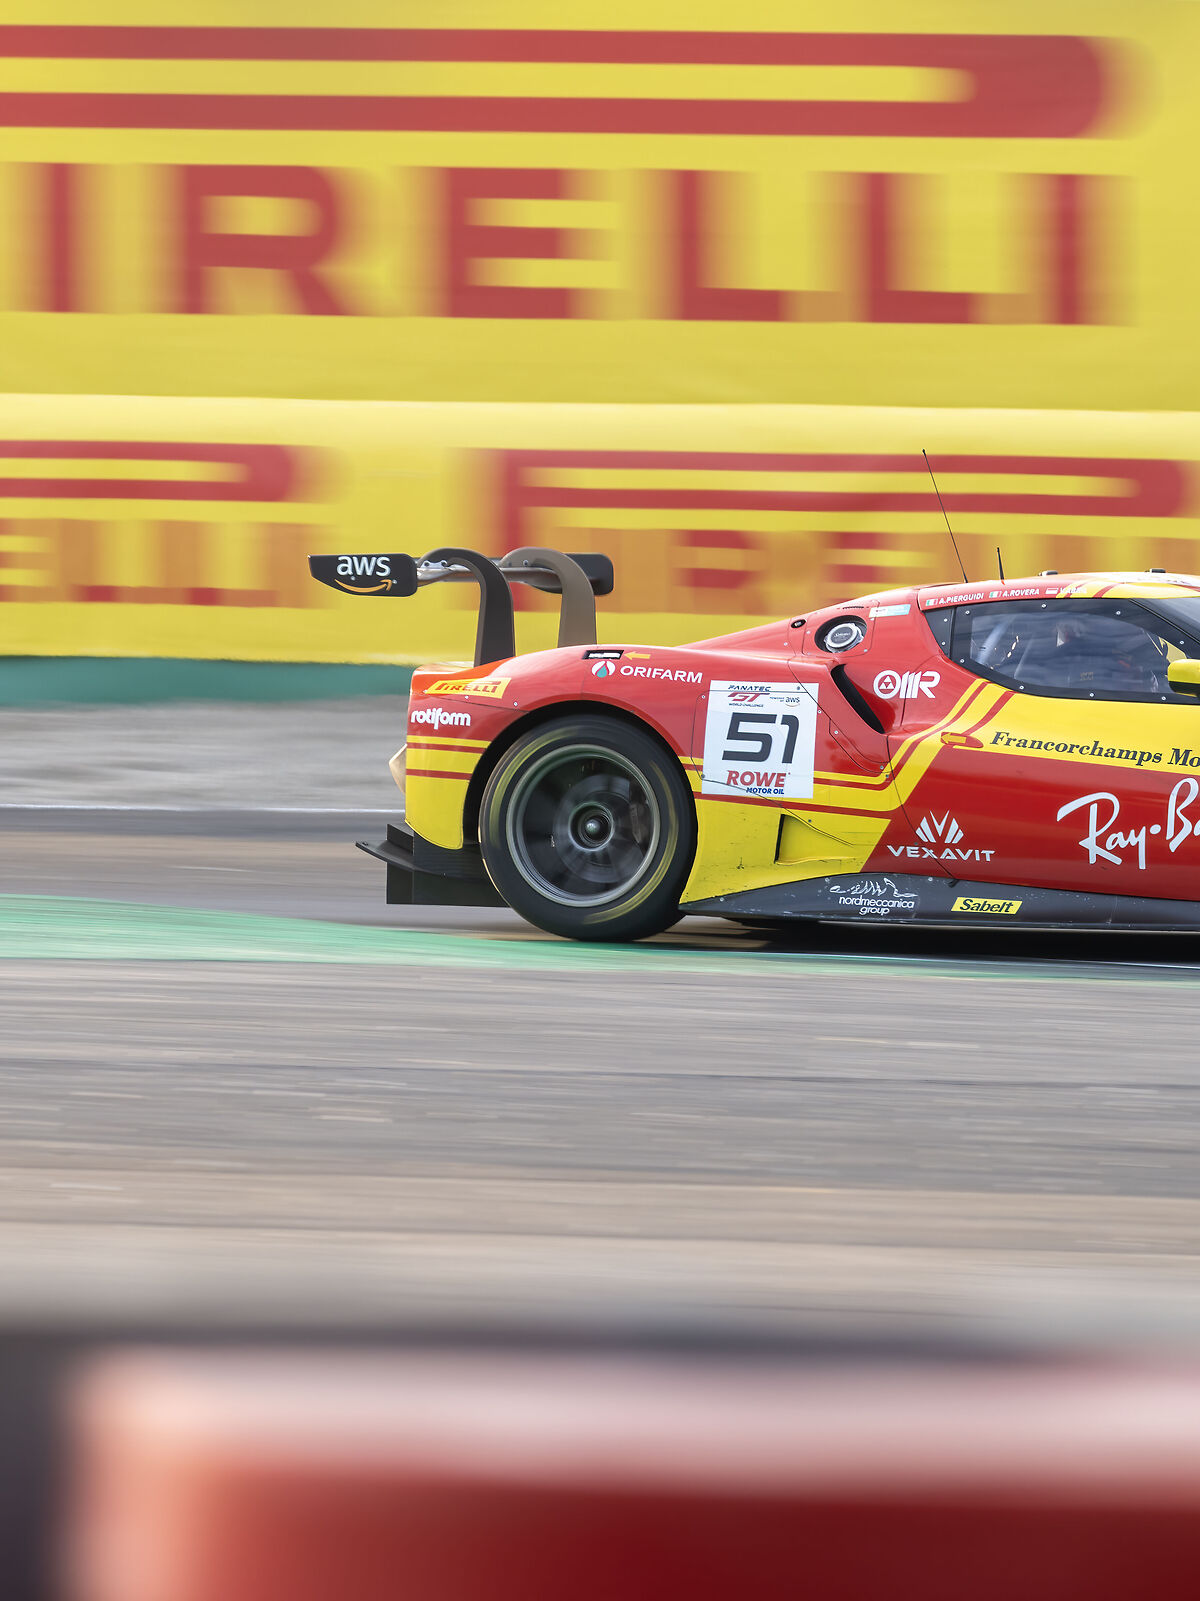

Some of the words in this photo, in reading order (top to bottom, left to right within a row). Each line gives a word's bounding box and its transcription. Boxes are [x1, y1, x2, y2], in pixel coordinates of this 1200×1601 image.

[336, 555, 392, 577] aws
[1002, 588, 1040, 597] A.ROVERA
[620, 665, 703, 683] ORIFARM
[410, 707, 471, 730] rotiform
[722, 711, 800, 764] 51
[990, 731, 1162, 766] Francorchamps
[727, 770, 787, 787] ROWE
[746, 787, 772, 795] MOTOR
[887, 845, 996, 862] VEXAVIT
[839, 895, 915, 908] nordmeccanica
[959, 898, 1014, 914] Sabelt
[859, 907, 890, 915] group
